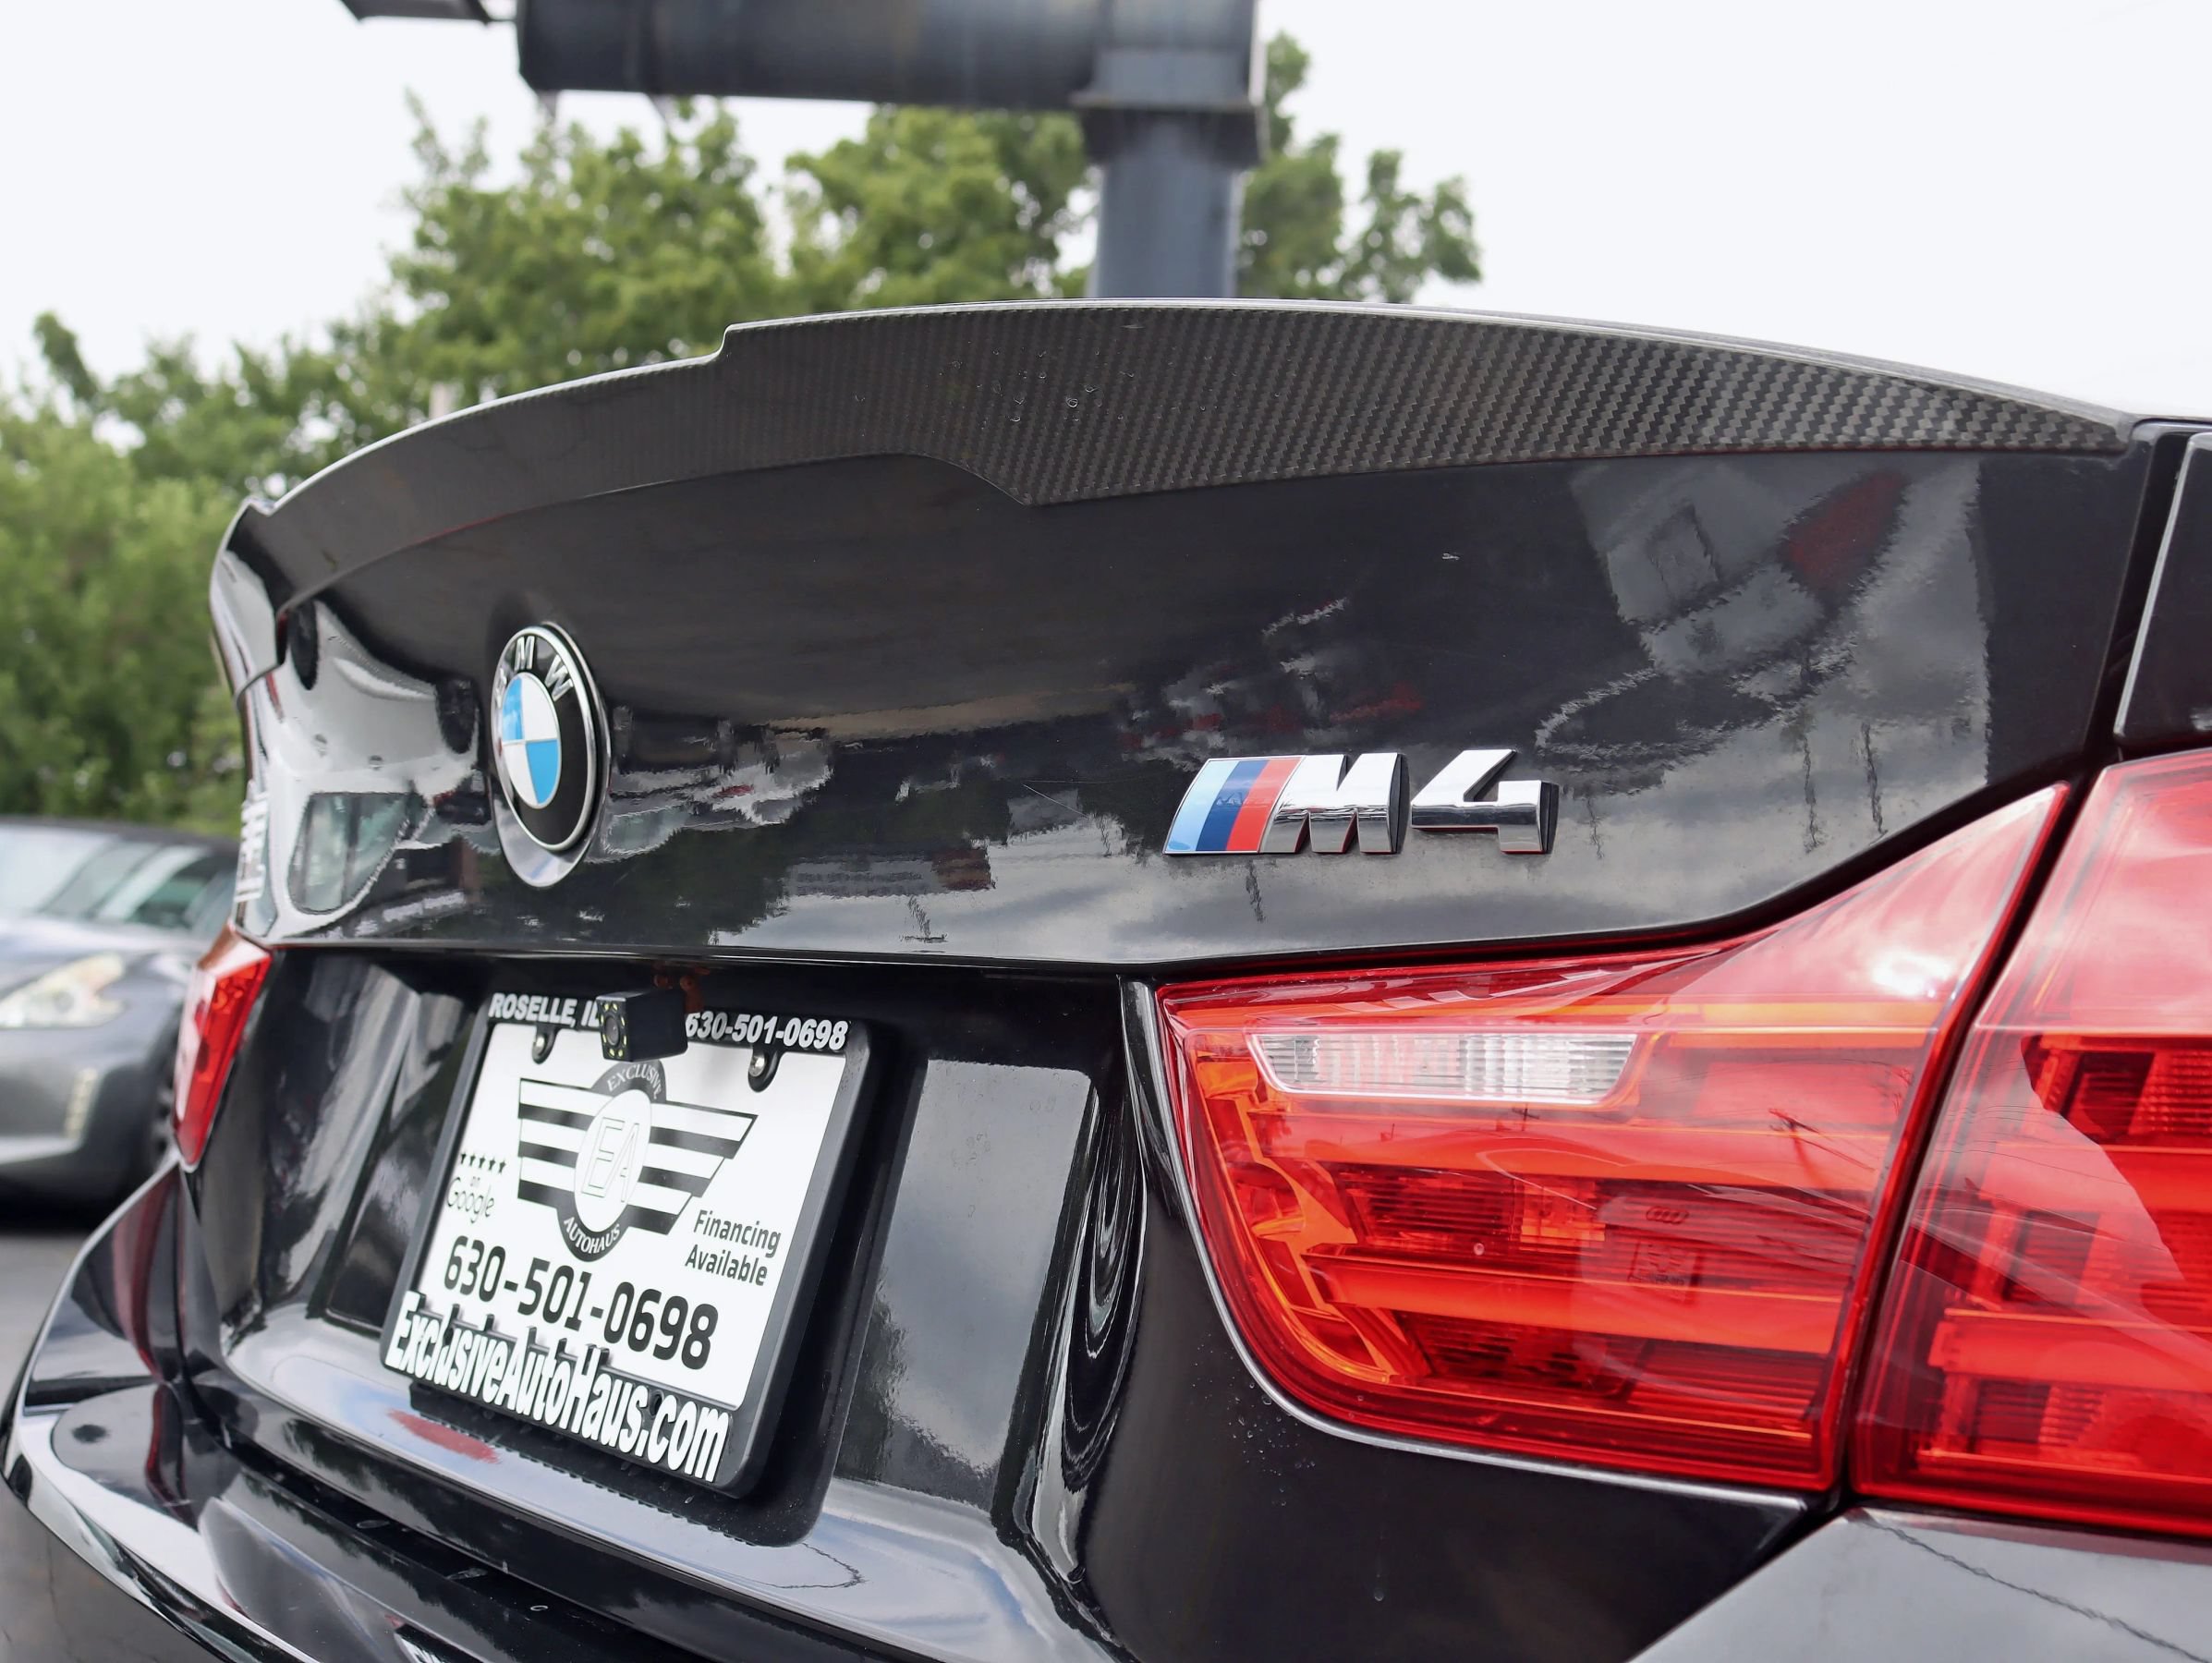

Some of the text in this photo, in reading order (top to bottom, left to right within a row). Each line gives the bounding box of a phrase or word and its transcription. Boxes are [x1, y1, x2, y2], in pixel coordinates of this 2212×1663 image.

[494, 636, 574, 709] BMW
[1259, 749, 1559, 854] M4
[488, 992, 848, 1050] ROSELLE, IL 630-501-0698
[607, 1063, 662, 1099] EXCLUSIVE
[446, 1176, 495, 1224] Google
[564, 1216, 621, 1254] AUTOHAUS
[693, 1208, 782, 1258] Financing
[685, 1244, 768, 1286] Available
[444, 1235, 719, 1370] 630-501-0698
[384, 1290, 730, 1484] ExclusiveAutoHaus.com
